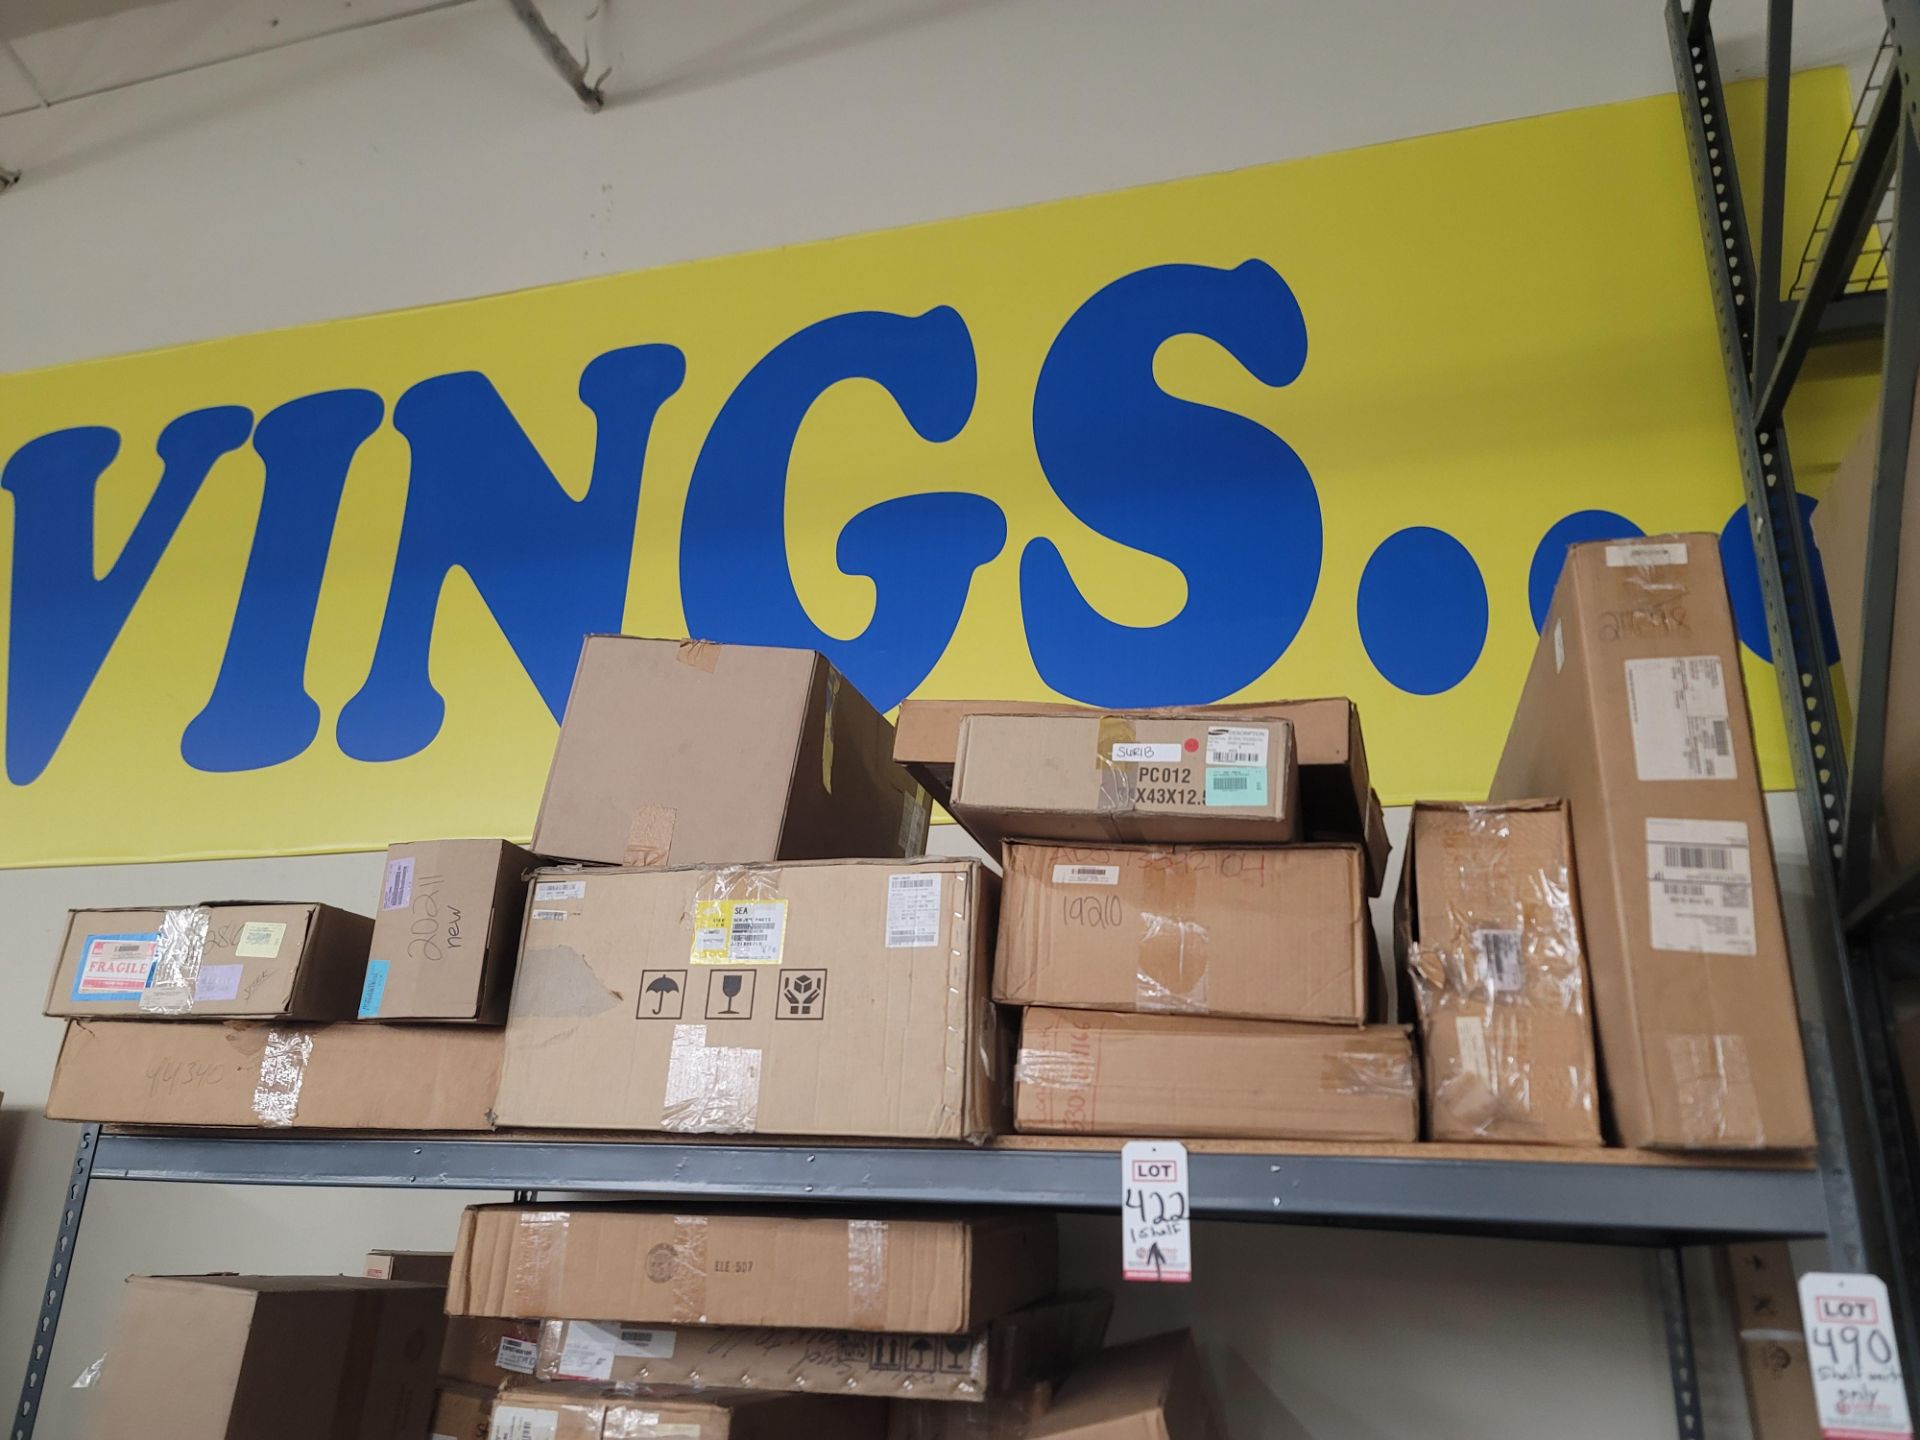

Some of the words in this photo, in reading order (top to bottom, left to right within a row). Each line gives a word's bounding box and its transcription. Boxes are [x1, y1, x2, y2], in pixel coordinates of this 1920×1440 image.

[1139, 766, 1191, 784] PC012
[734, 906, 748, 915] SEA
[1062, 895, 1123, 930] 19210
[447, 905, 463, 949] new
[88, 960, 148, 975] FRAGILE
[1137, 1164, 1172, 1178] LOT
[1125, 1189, 1190, 1225] 422
[1823, 1302, 1868, 1319] LOT
[1812, 1326, 1892, 1379] 490
